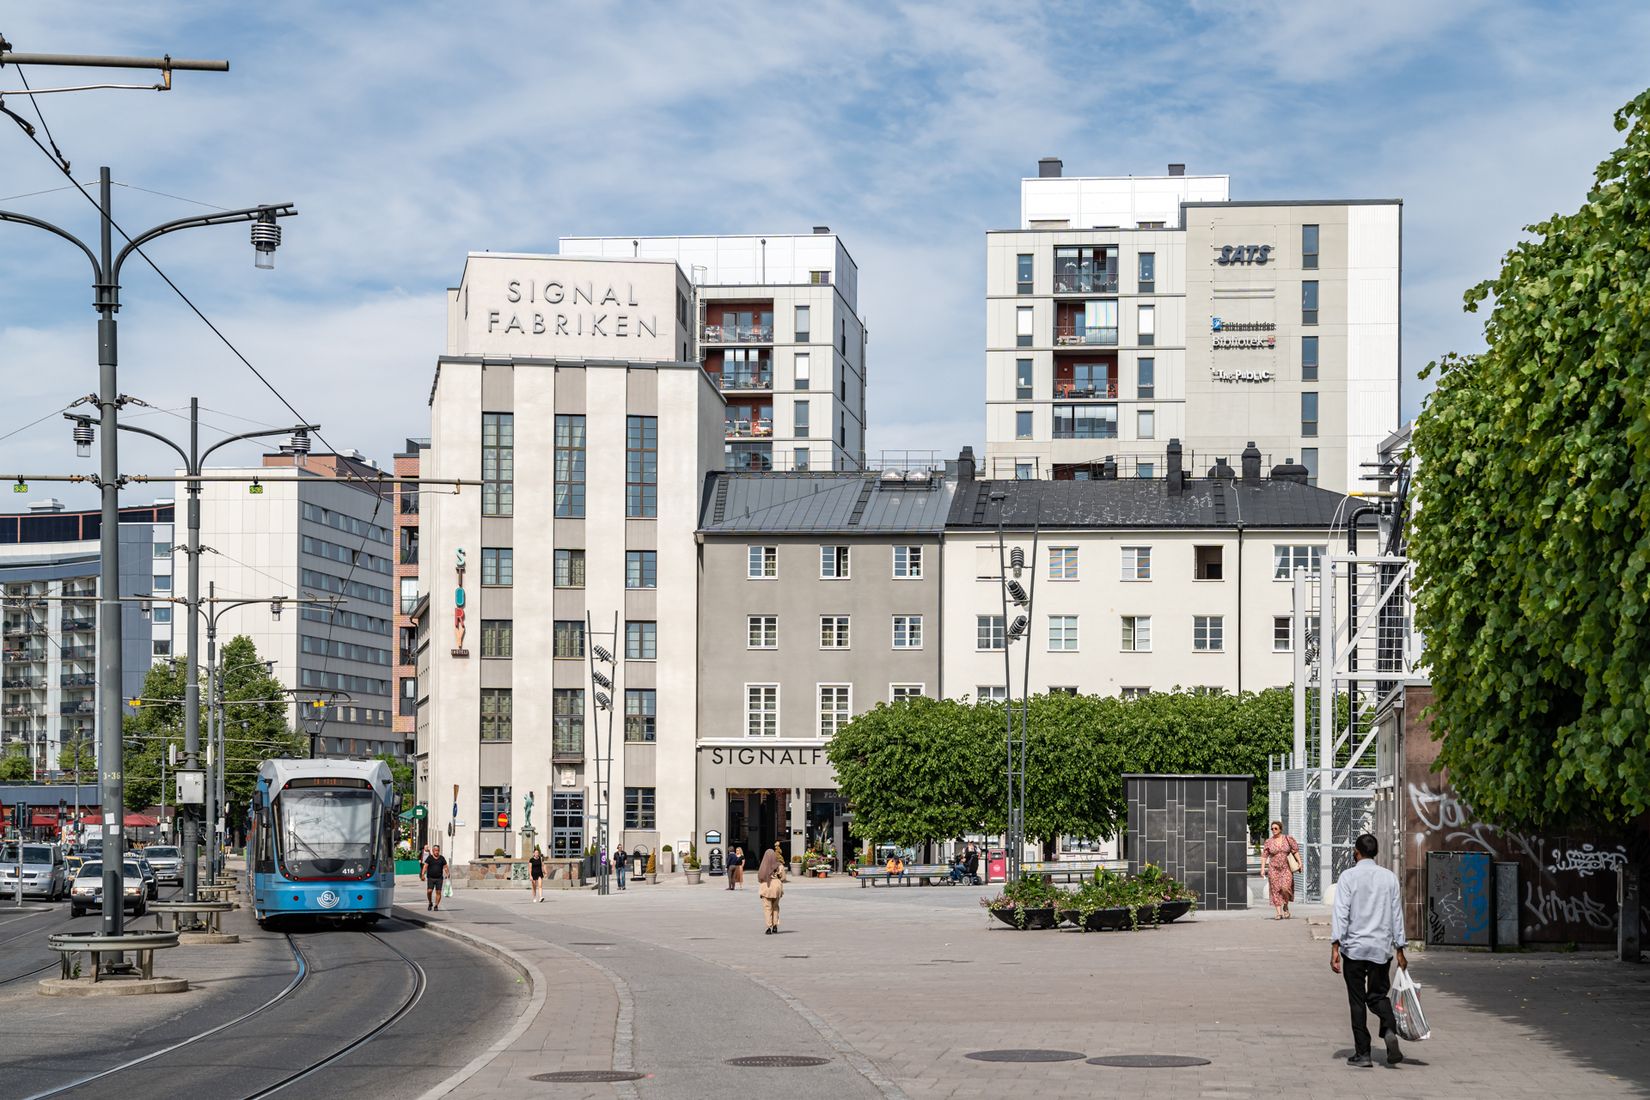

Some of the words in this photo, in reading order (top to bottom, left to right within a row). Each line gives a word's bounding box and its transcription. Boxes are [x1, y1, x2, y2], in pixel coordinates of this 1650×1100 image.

[1217, 244, 1271, 265] SATS
[506, 279, 639, 307] SIGNAL
[487, 309, 658, 338] FABRIKEN
[323, 893, 334, 901] SL
